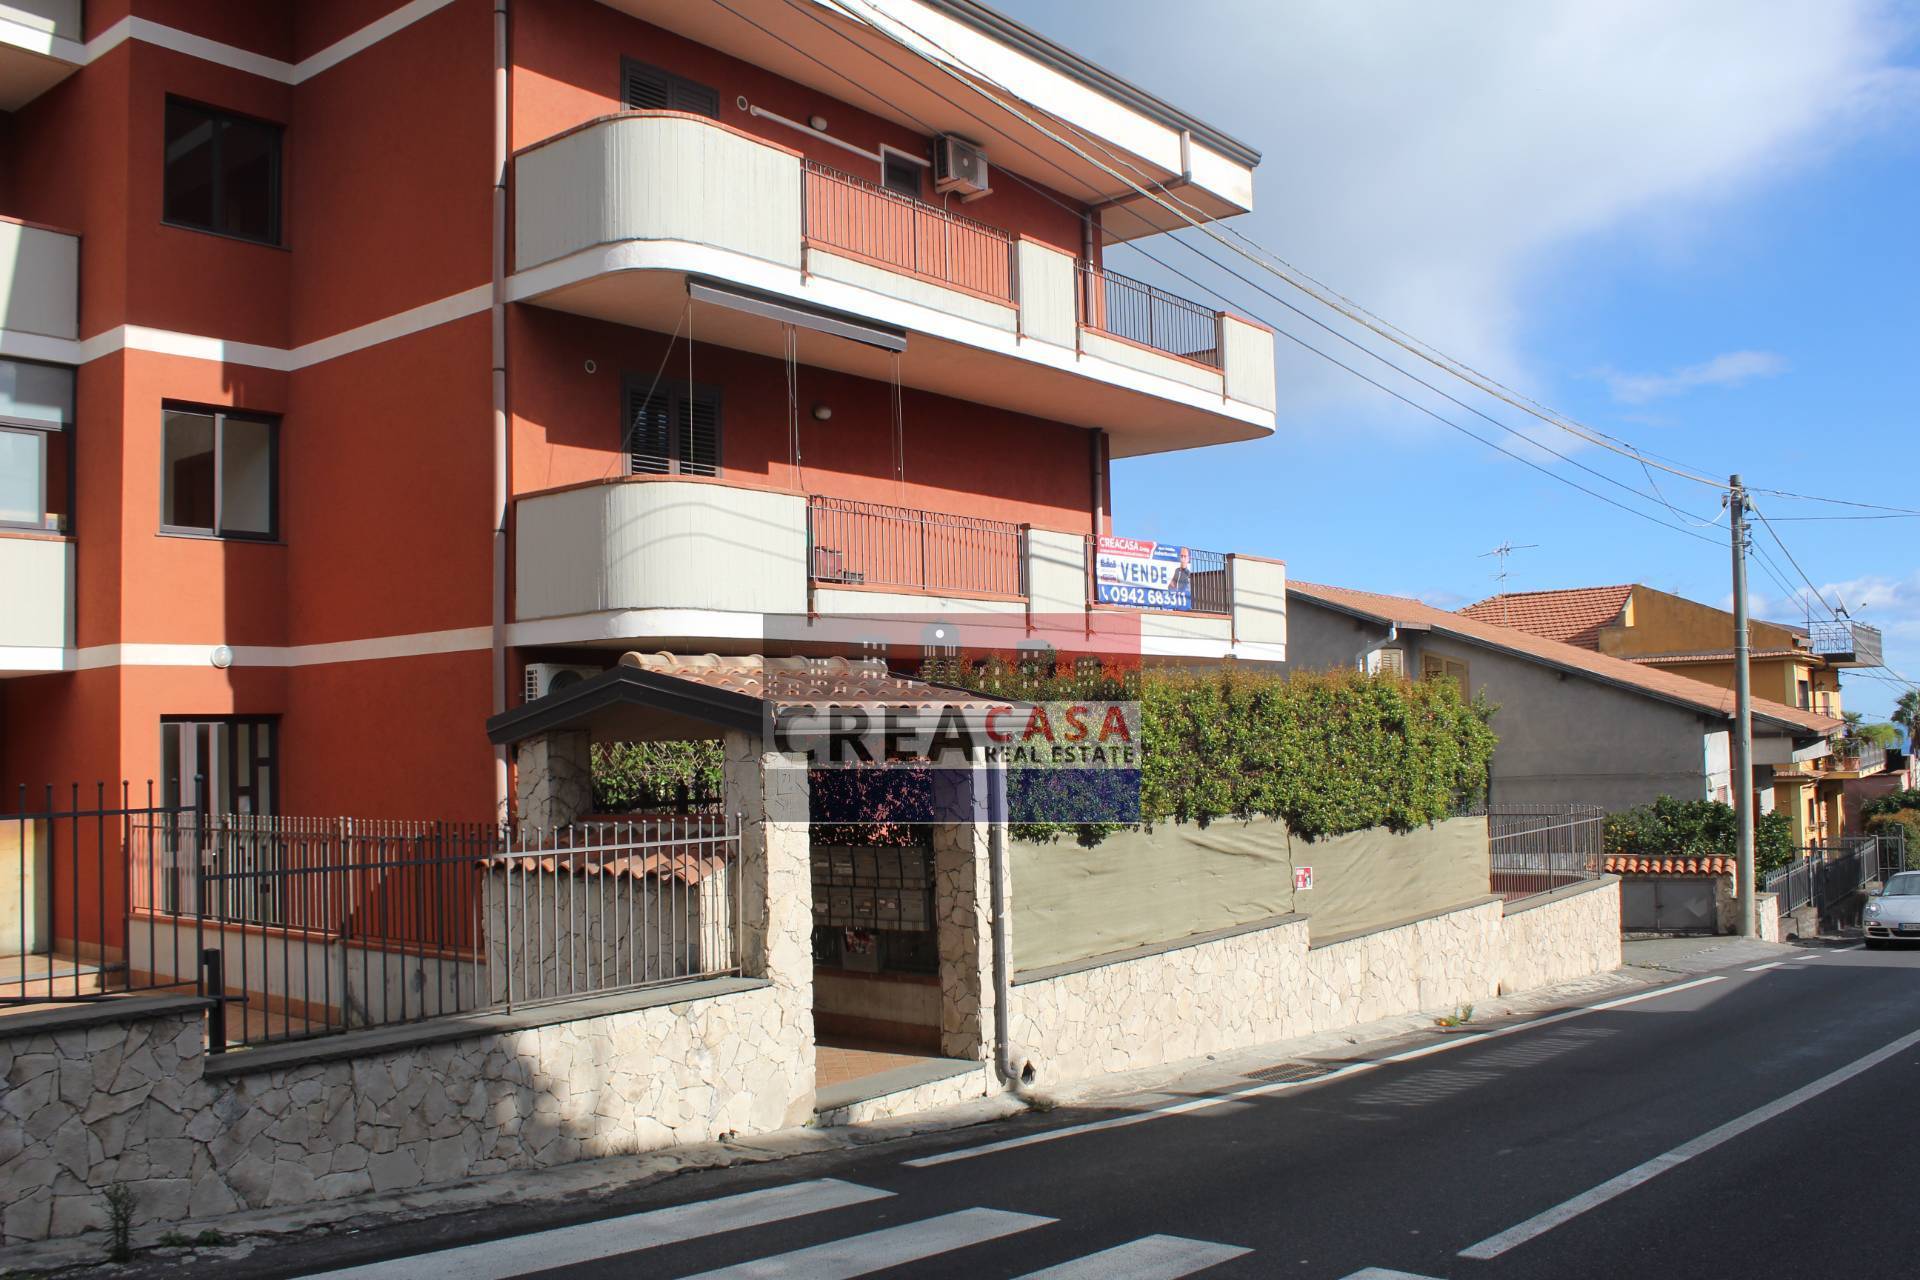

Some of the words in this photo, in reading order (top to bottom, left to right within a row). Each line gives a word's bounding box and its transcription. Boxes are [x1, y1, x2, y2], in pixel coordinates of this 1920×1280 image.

[1099, 537, 1139, 551] CREACASA
[1120, 562, 1168, 584] VENDE
[1110, 587, 1145, 603] 0942
[1148, 591, 1187, 606] 683311
